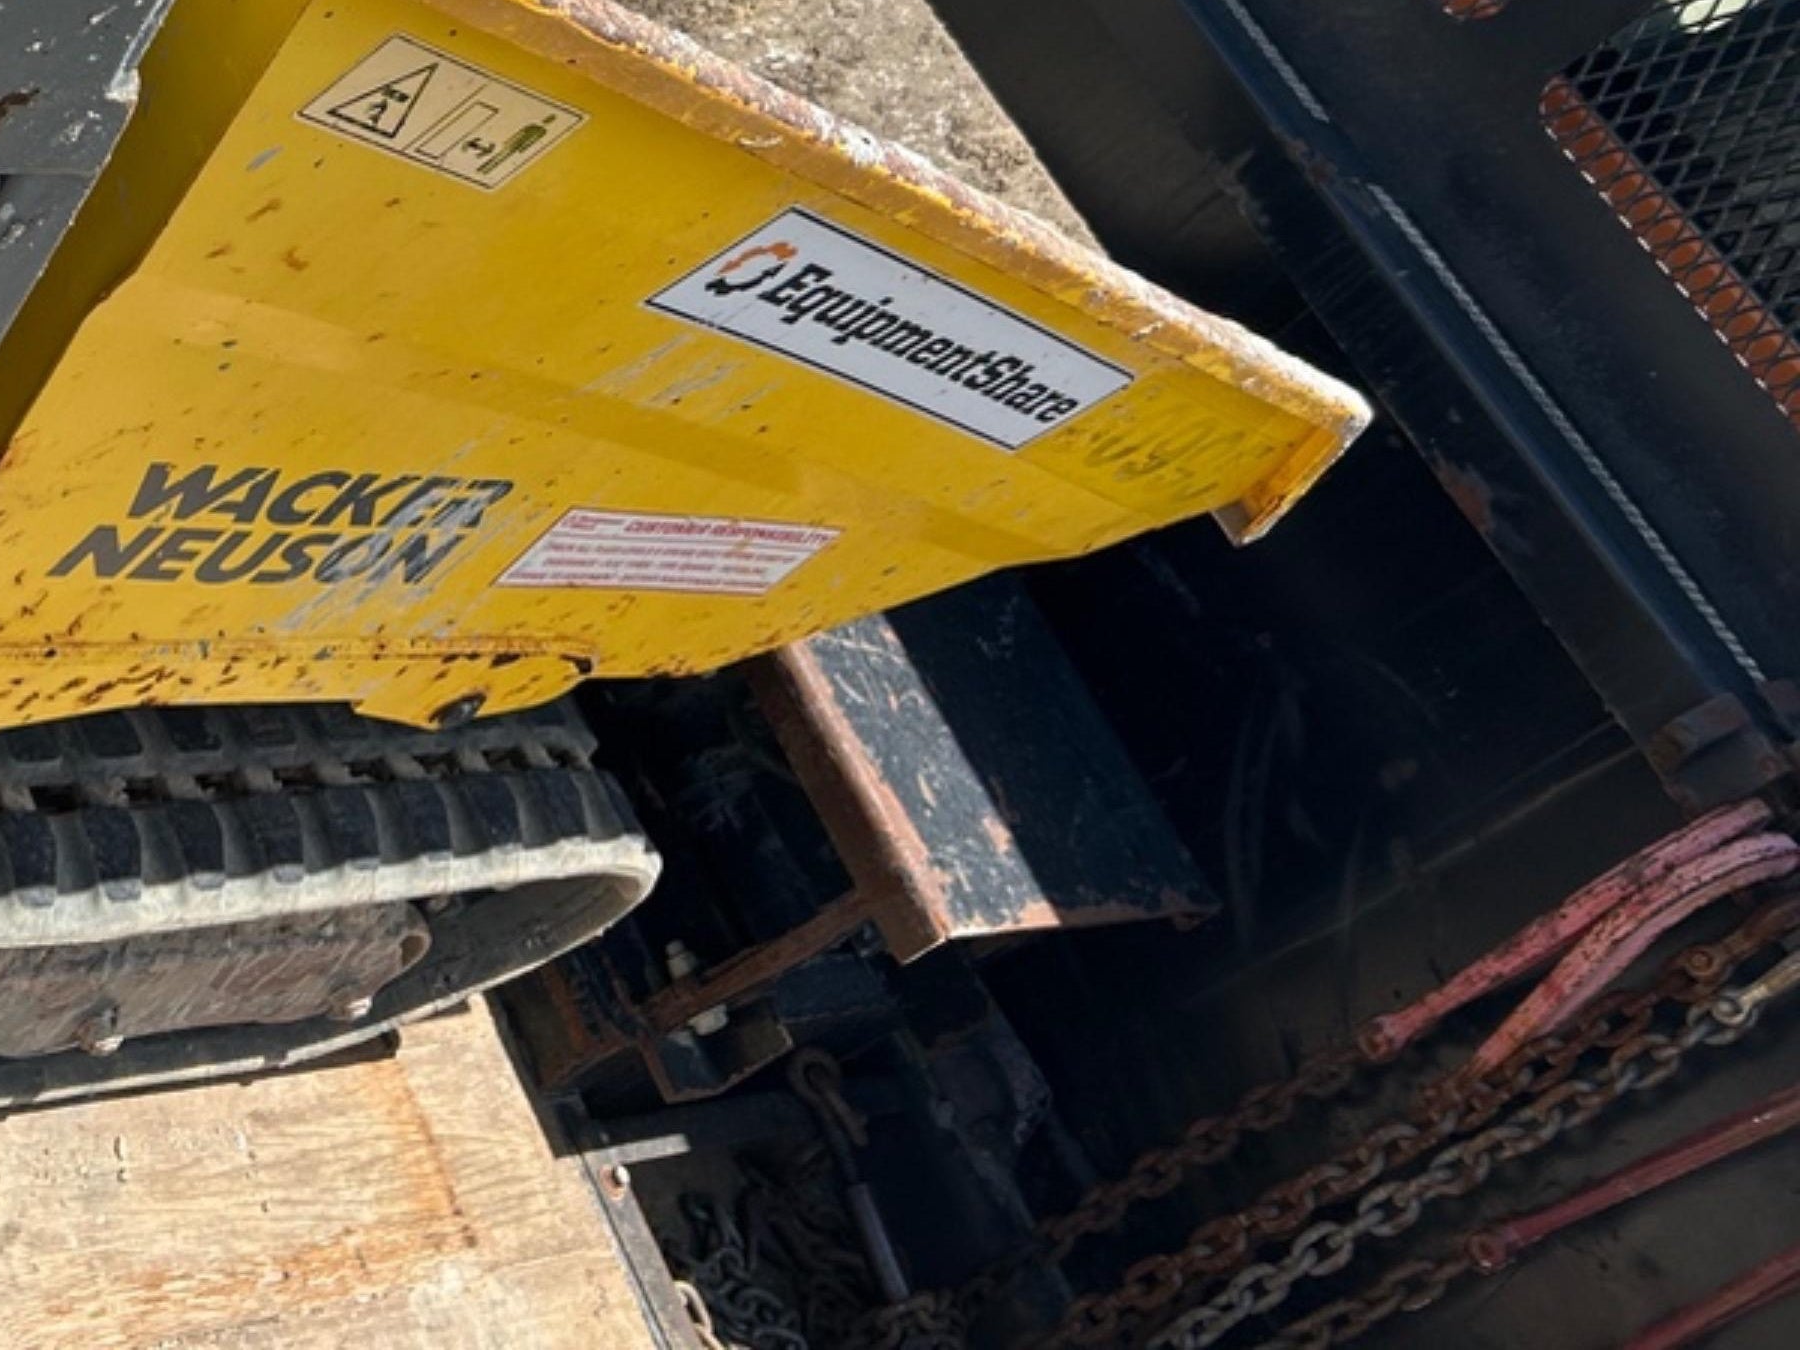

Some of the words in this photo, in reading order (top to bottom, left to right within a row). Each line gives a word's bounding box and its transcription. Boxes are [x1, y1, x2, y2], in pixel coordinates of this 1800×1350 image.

[757, 263, 1079, 424] EquipmentShare
[126, 461, 514, 530] WACKER
[45, 524, 466, 585] NEUSON
